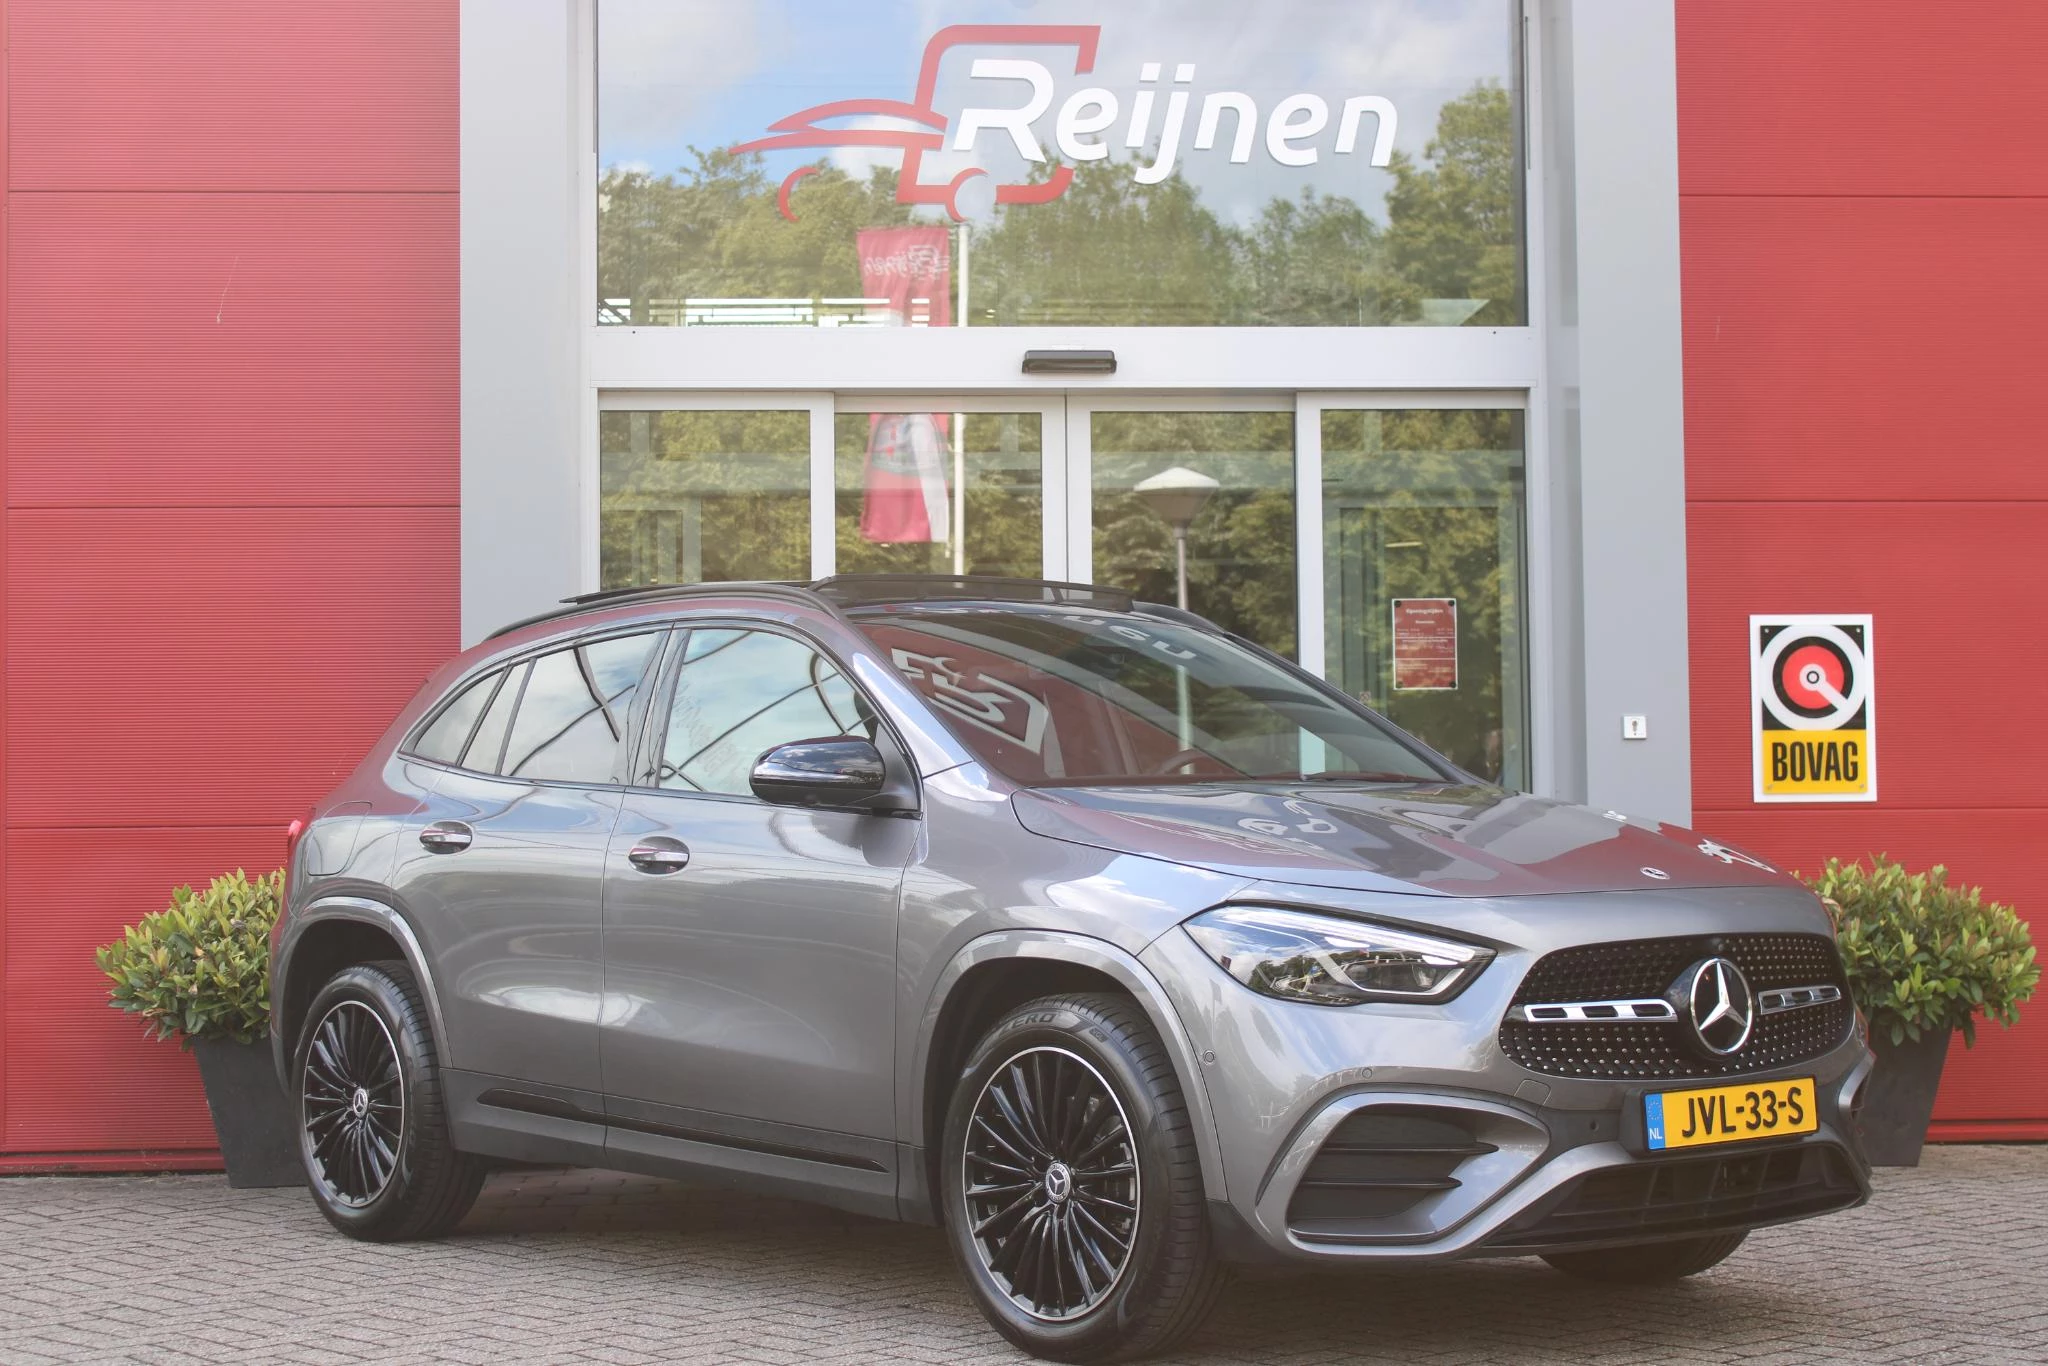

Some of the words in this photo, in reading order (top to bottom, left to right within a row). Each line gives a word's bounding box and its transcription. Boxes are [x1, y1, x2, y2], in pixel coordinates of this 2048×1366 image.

[952, 59, 1398, 184] Reijnen
[1772, 741, 1859, 782] BOVAG
[1649, 1128, 1663, 1140] NL
[1681, 1086, 1804, 1138] JVL-33-S
